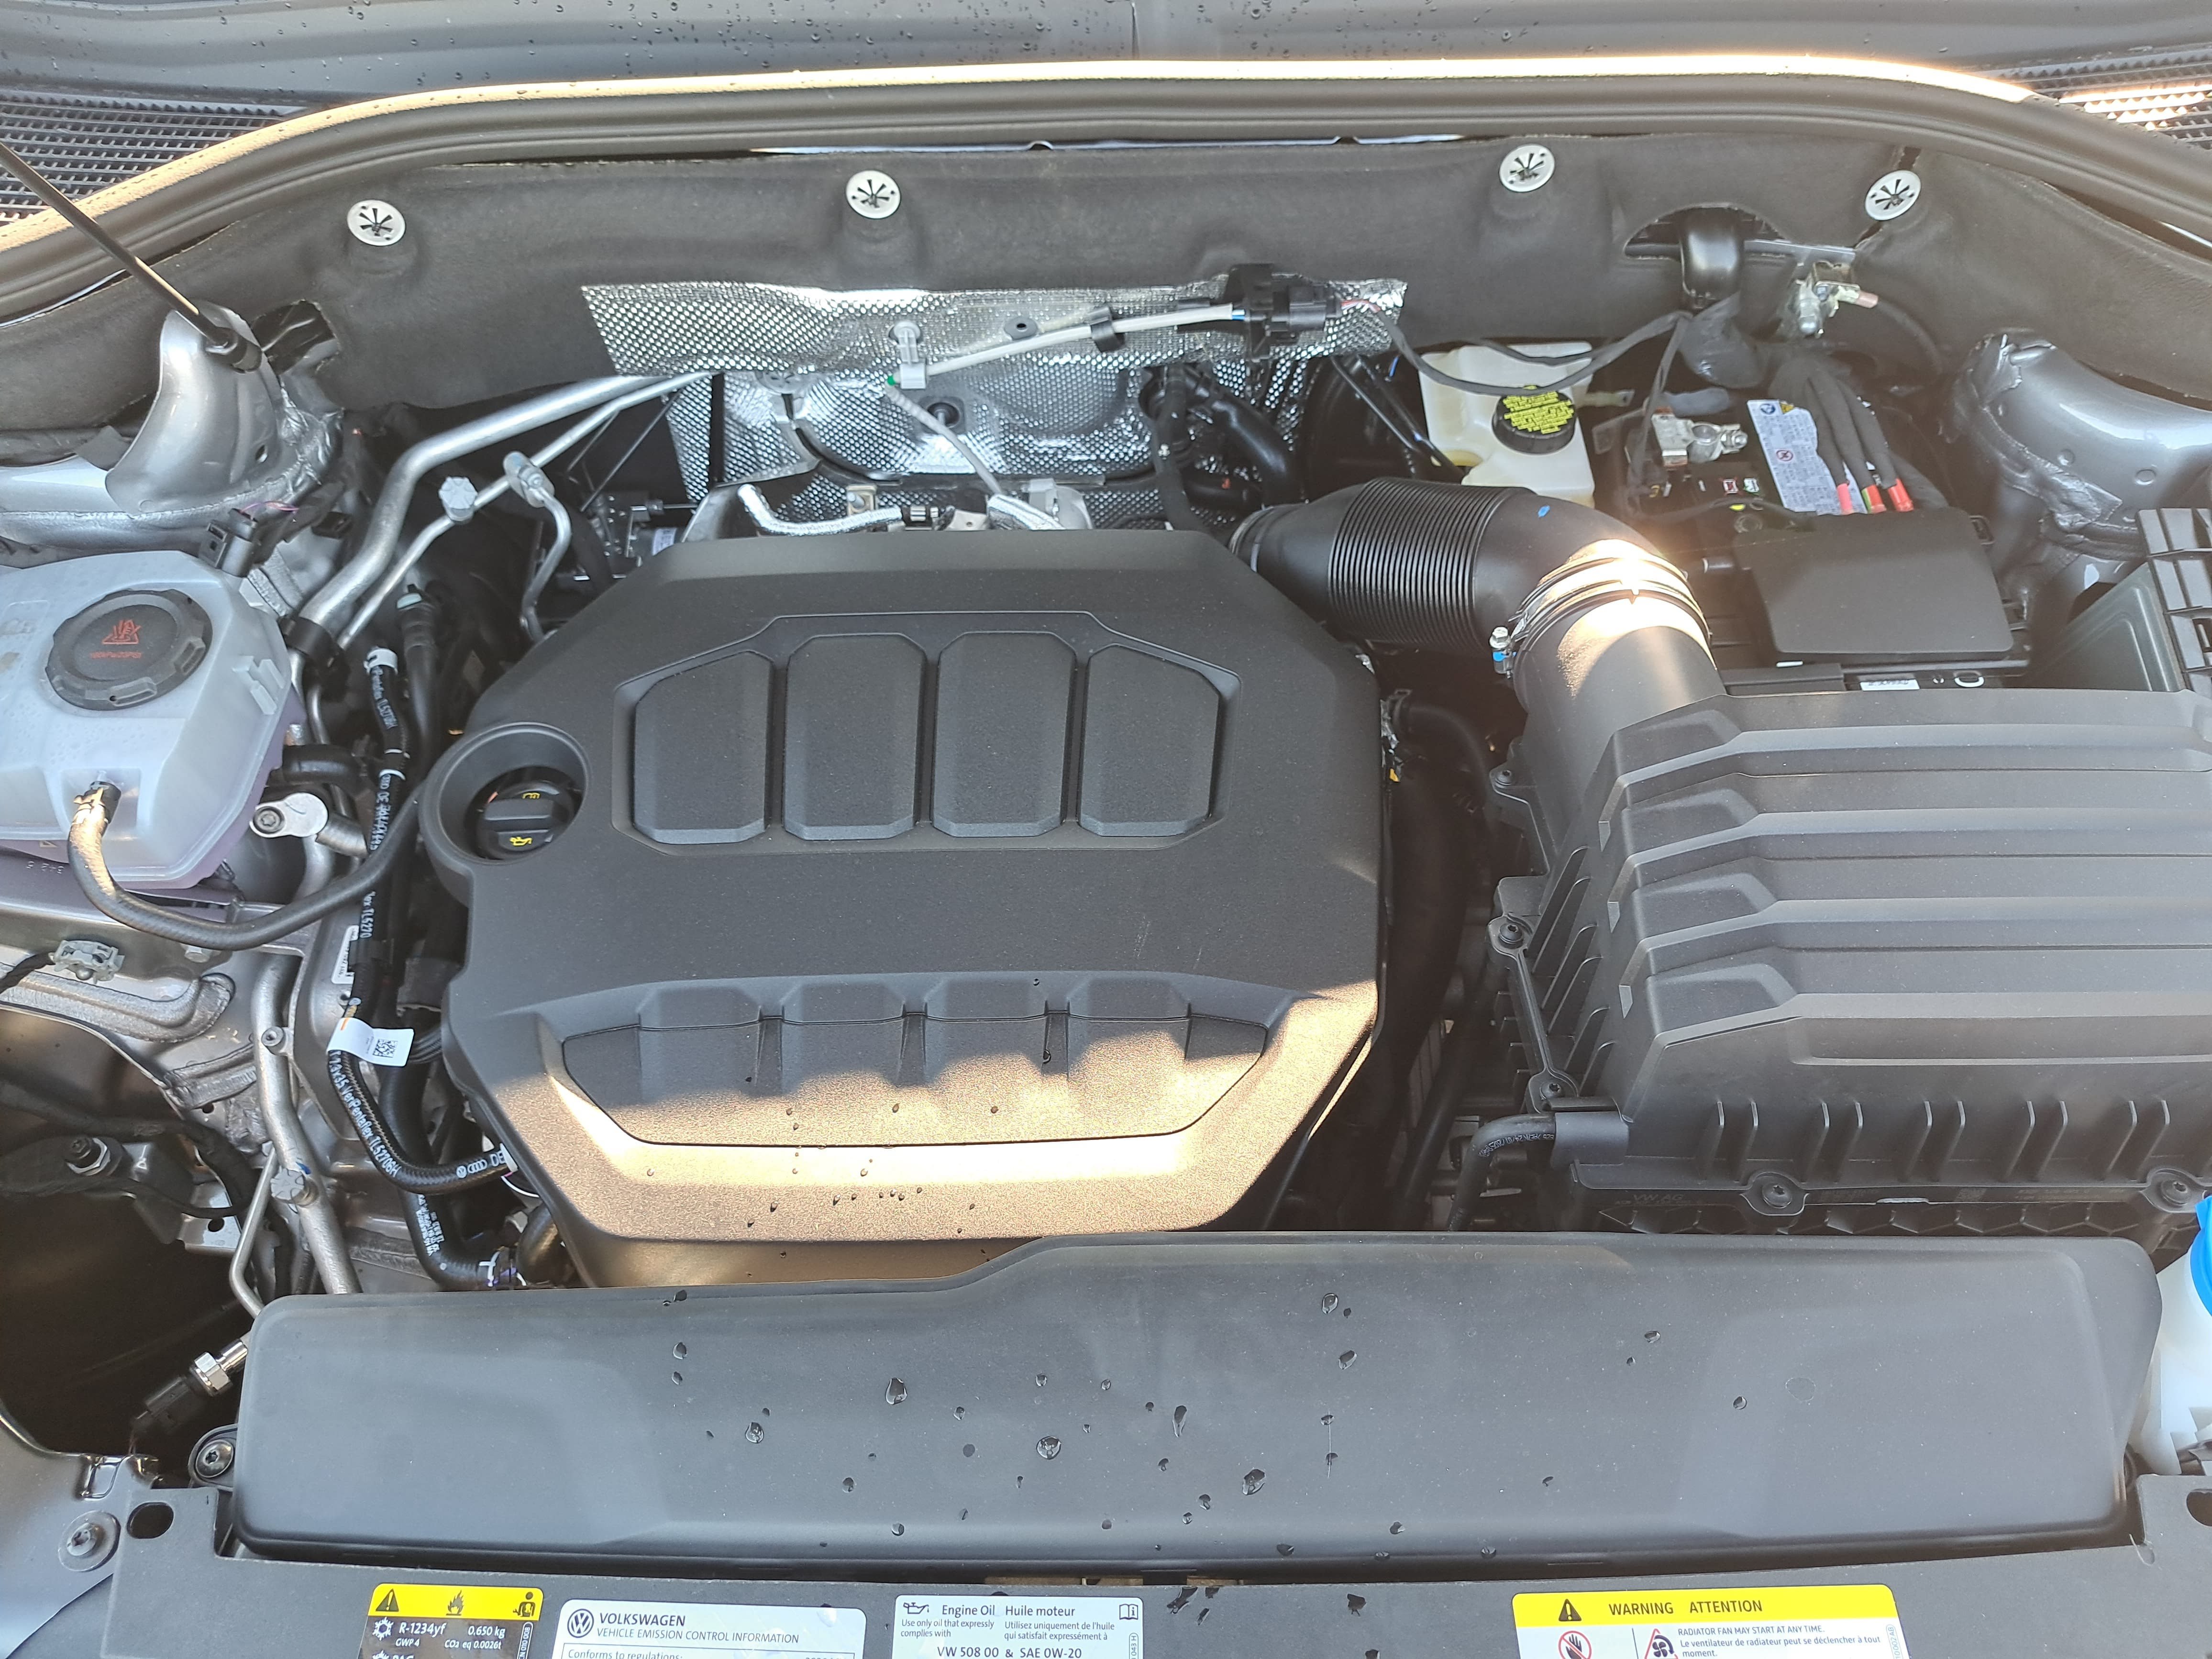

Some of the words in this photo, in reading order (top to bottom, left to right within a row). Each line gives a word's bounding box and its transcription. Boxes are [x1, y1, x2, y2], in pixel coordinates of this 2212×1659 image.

[942, 1604, 977, 1618] Engine
[981, 1604, 995, 1615] Oil
[1006, 1605, 1033, 1616] Huile
[1036, 1606, 1075, 1616] moteur
[1609, 1602, 1673, 1615] WARNING
[1690, 1600, 1762, 1614] ATTENTION
[600, 1612, 686, 1626] VOLKSWAGEN
[917, 1619, 932, 1629] only
[933, 1619, 942, 1627] oil
[944, 1619, 959, 1627] that
[961, 1619, 995, 1629] expressly
[399, 1622, 447, 1638] R-1234yf
[468, 1626, 491, 1637] 0.650
[494, 1626, 505, 1638] kg
[1005, 1621, 1032, 1629] Utilisez
[1034, 1622, 1079, 1631] uniquement
[1081, 1621, 1091, 1630] de
[1092, 1621, 1115, 1630] l'huile
[1678, 1627, 1715, 1636] RADIATOR
[1718, 1627, 1733, 1635] FAN
[1735, 1627, 1750, 1635] MAY
[1752, 1626, 1774, 1634] START
[1804, 1625, 1825, 1633] TIME.
[597, 1627, 634, 1638] VEHICLE
[637, 1628, 683, 1639] EMISSION
[686, 1630, 729, 1641] CONTROL
[732, 1633, 799, 1643] INFORMATION
[900, 1629, 933, 1639] complies
[934, 1629, 951, 1637] with
[1004, 1631, 1016, 1641] qui
[1018, 1631, 1047, 1640] satisfait
[1049, 1632, 1101, 1642] expressément
[462, 1641, 472, 1650] eq
[1680, 1639, 1689, 1648] Le
[1691, 1638, 1733, 1647] ventilateur
[1735, 1638, 1744, 1646] de
[1747, 1637, 1781, 1646] radiateur
[1783, 1637, 1801, 1647] peut
[1814, 1636, 1856, 1645] déclencher
[1858, 1635, 1862, 1643] à
[568, 1649, 612, 1659] Conforms
[616, 1651, 625, 1659] to
[937, 1646, 957, 1657] VW
[960, 1647, 981, 1658] 508
[984, 1647, 999, 1658] 00
[1006, 1649, 1013, 1658] &
[1020, 1648, 1040, 1658] SAE
[1044, 1648, 1082, 1659] 0W-20
